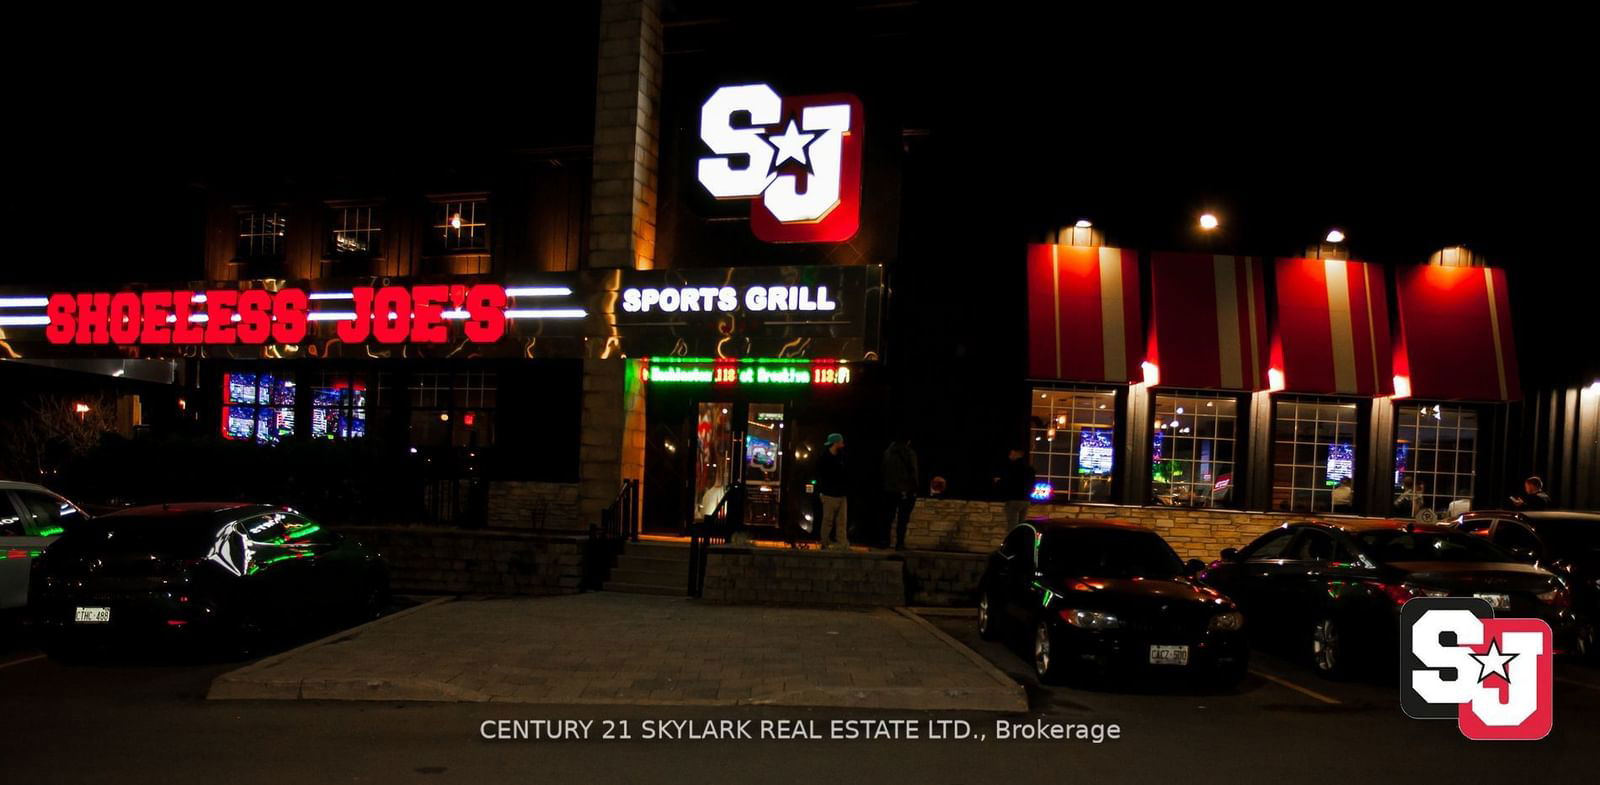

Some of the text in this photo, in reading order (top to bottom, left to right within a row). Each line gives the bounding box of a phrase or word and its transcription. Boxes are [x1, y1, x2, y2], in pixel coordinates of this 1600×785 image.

[47, 284, 506, 344] SHOELESS JOE'S
[623, 286, 836, 312] SPORTS GRILL
